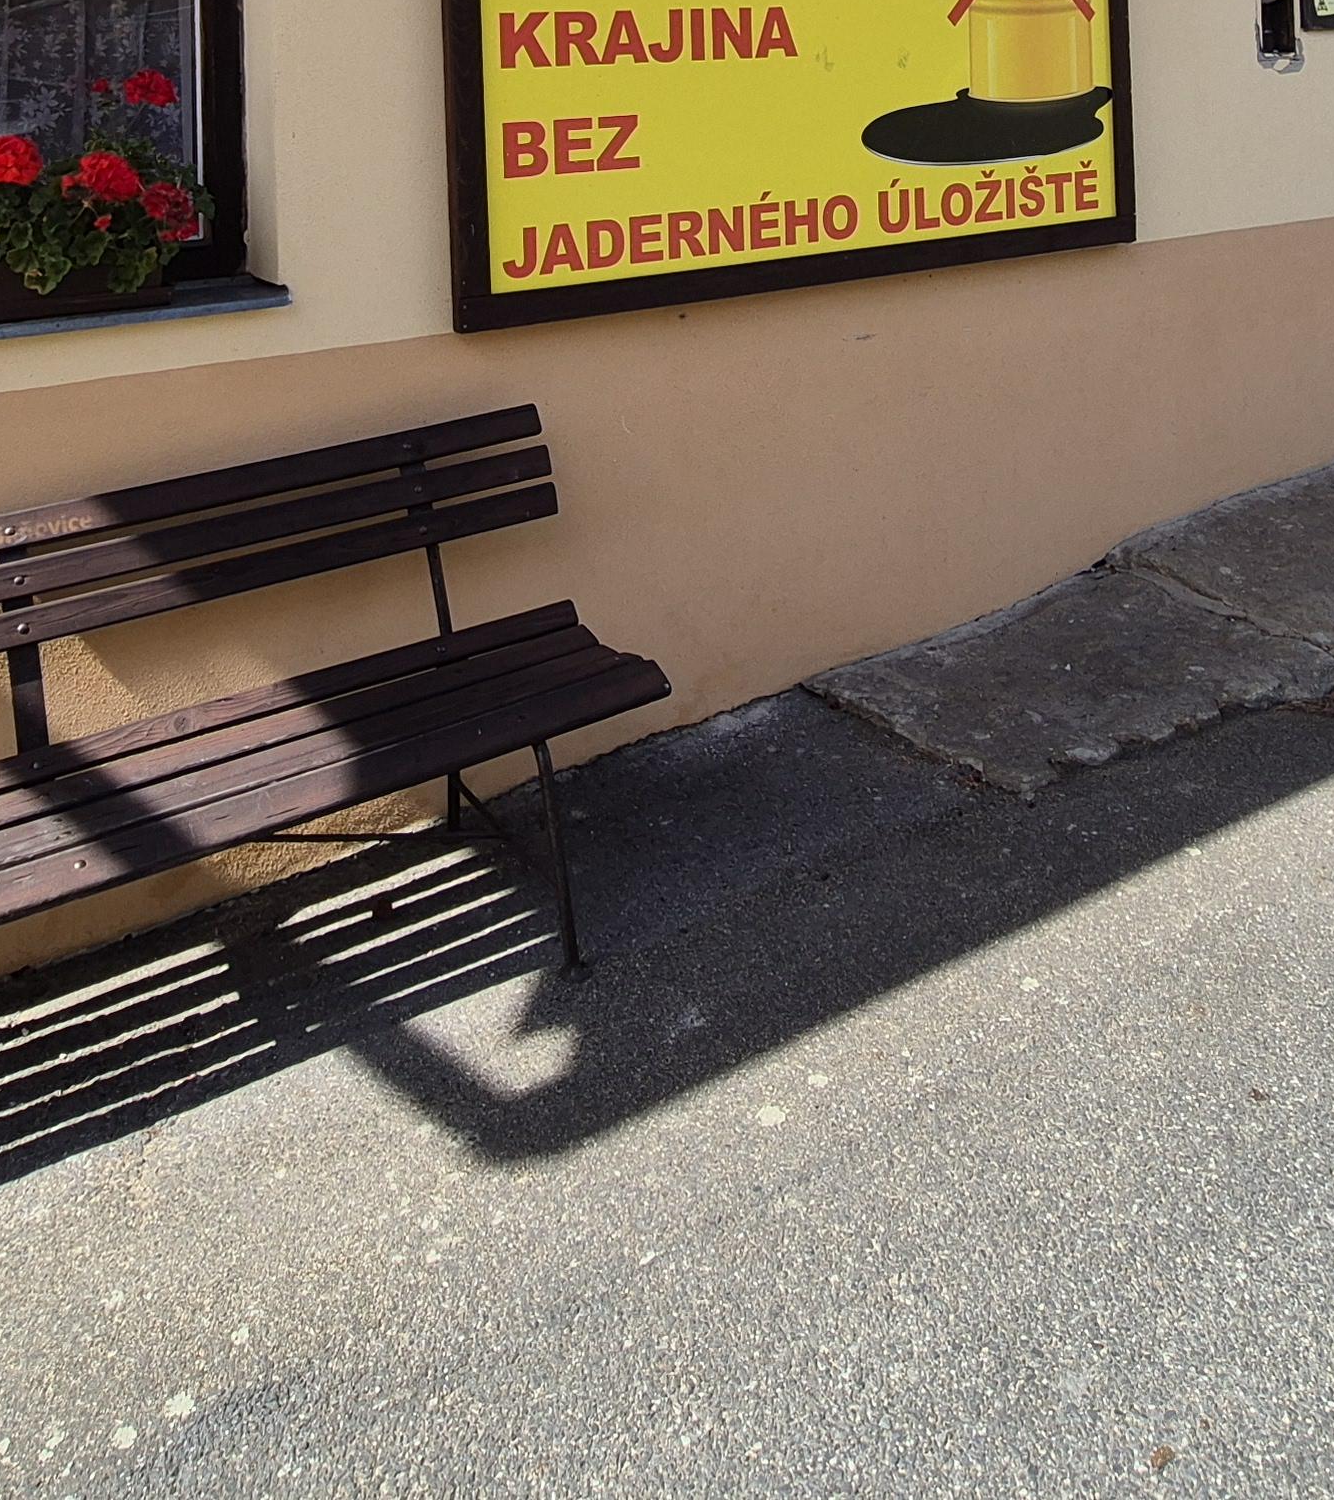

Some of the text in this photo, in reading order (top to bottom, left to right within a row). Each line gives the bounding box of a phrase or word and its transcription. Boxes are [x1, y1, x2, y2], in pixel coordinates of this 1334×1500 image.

[498, 6, 798, 69] KRAJINA
[502, 114, 641, 180] BEZ
[502, 160, 1100, 279] JADERNÉHO ÚLOŽIŠTĚ
